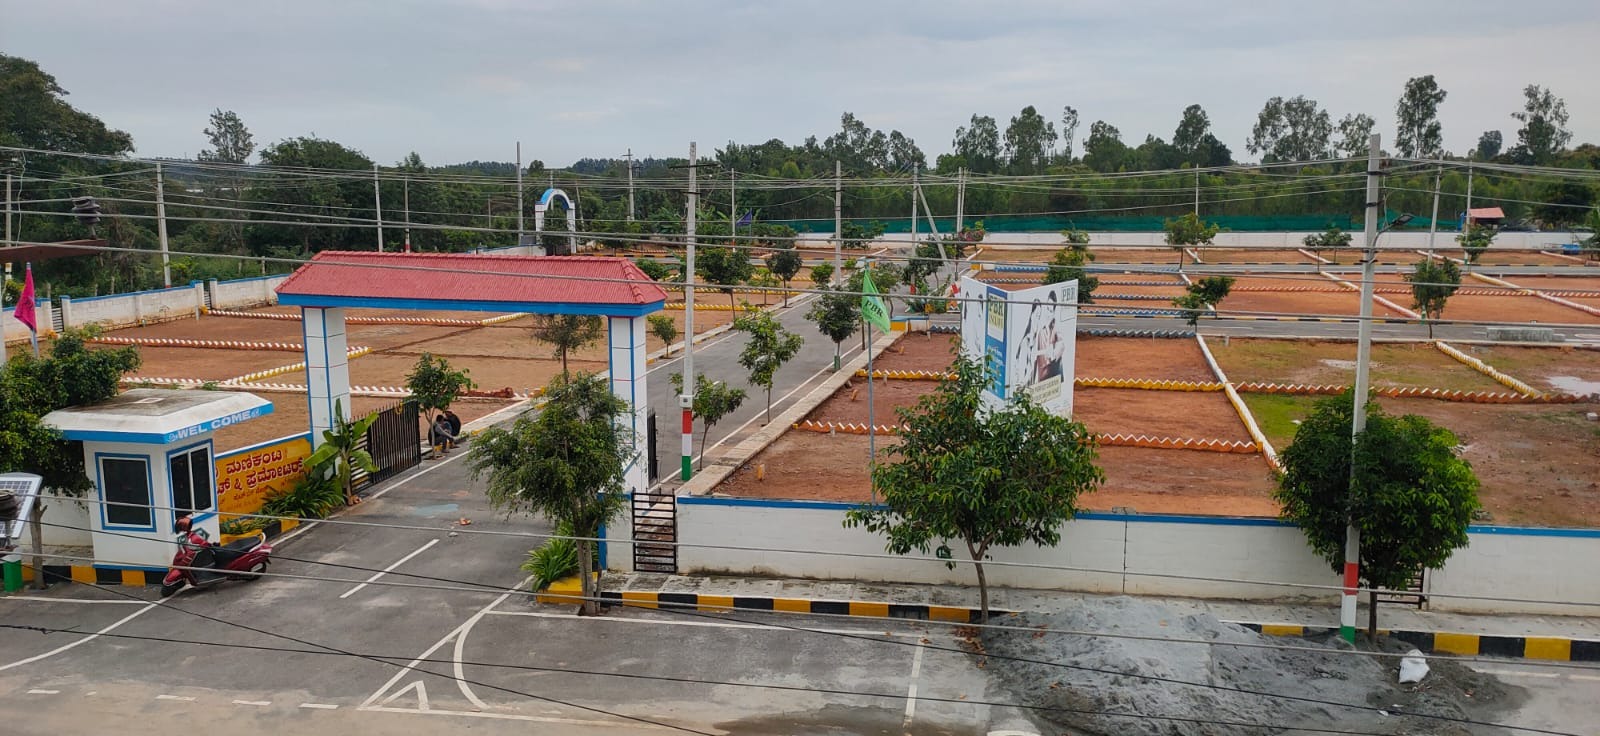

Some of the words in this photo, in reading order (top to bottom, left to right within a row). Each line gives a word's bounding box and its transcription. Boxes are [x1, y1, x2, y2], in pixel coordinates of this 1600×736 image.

[864, 300, 884, 317] PBR
[177, 424, 208, 439] WEL
[211, 410, 252, 430] COME
